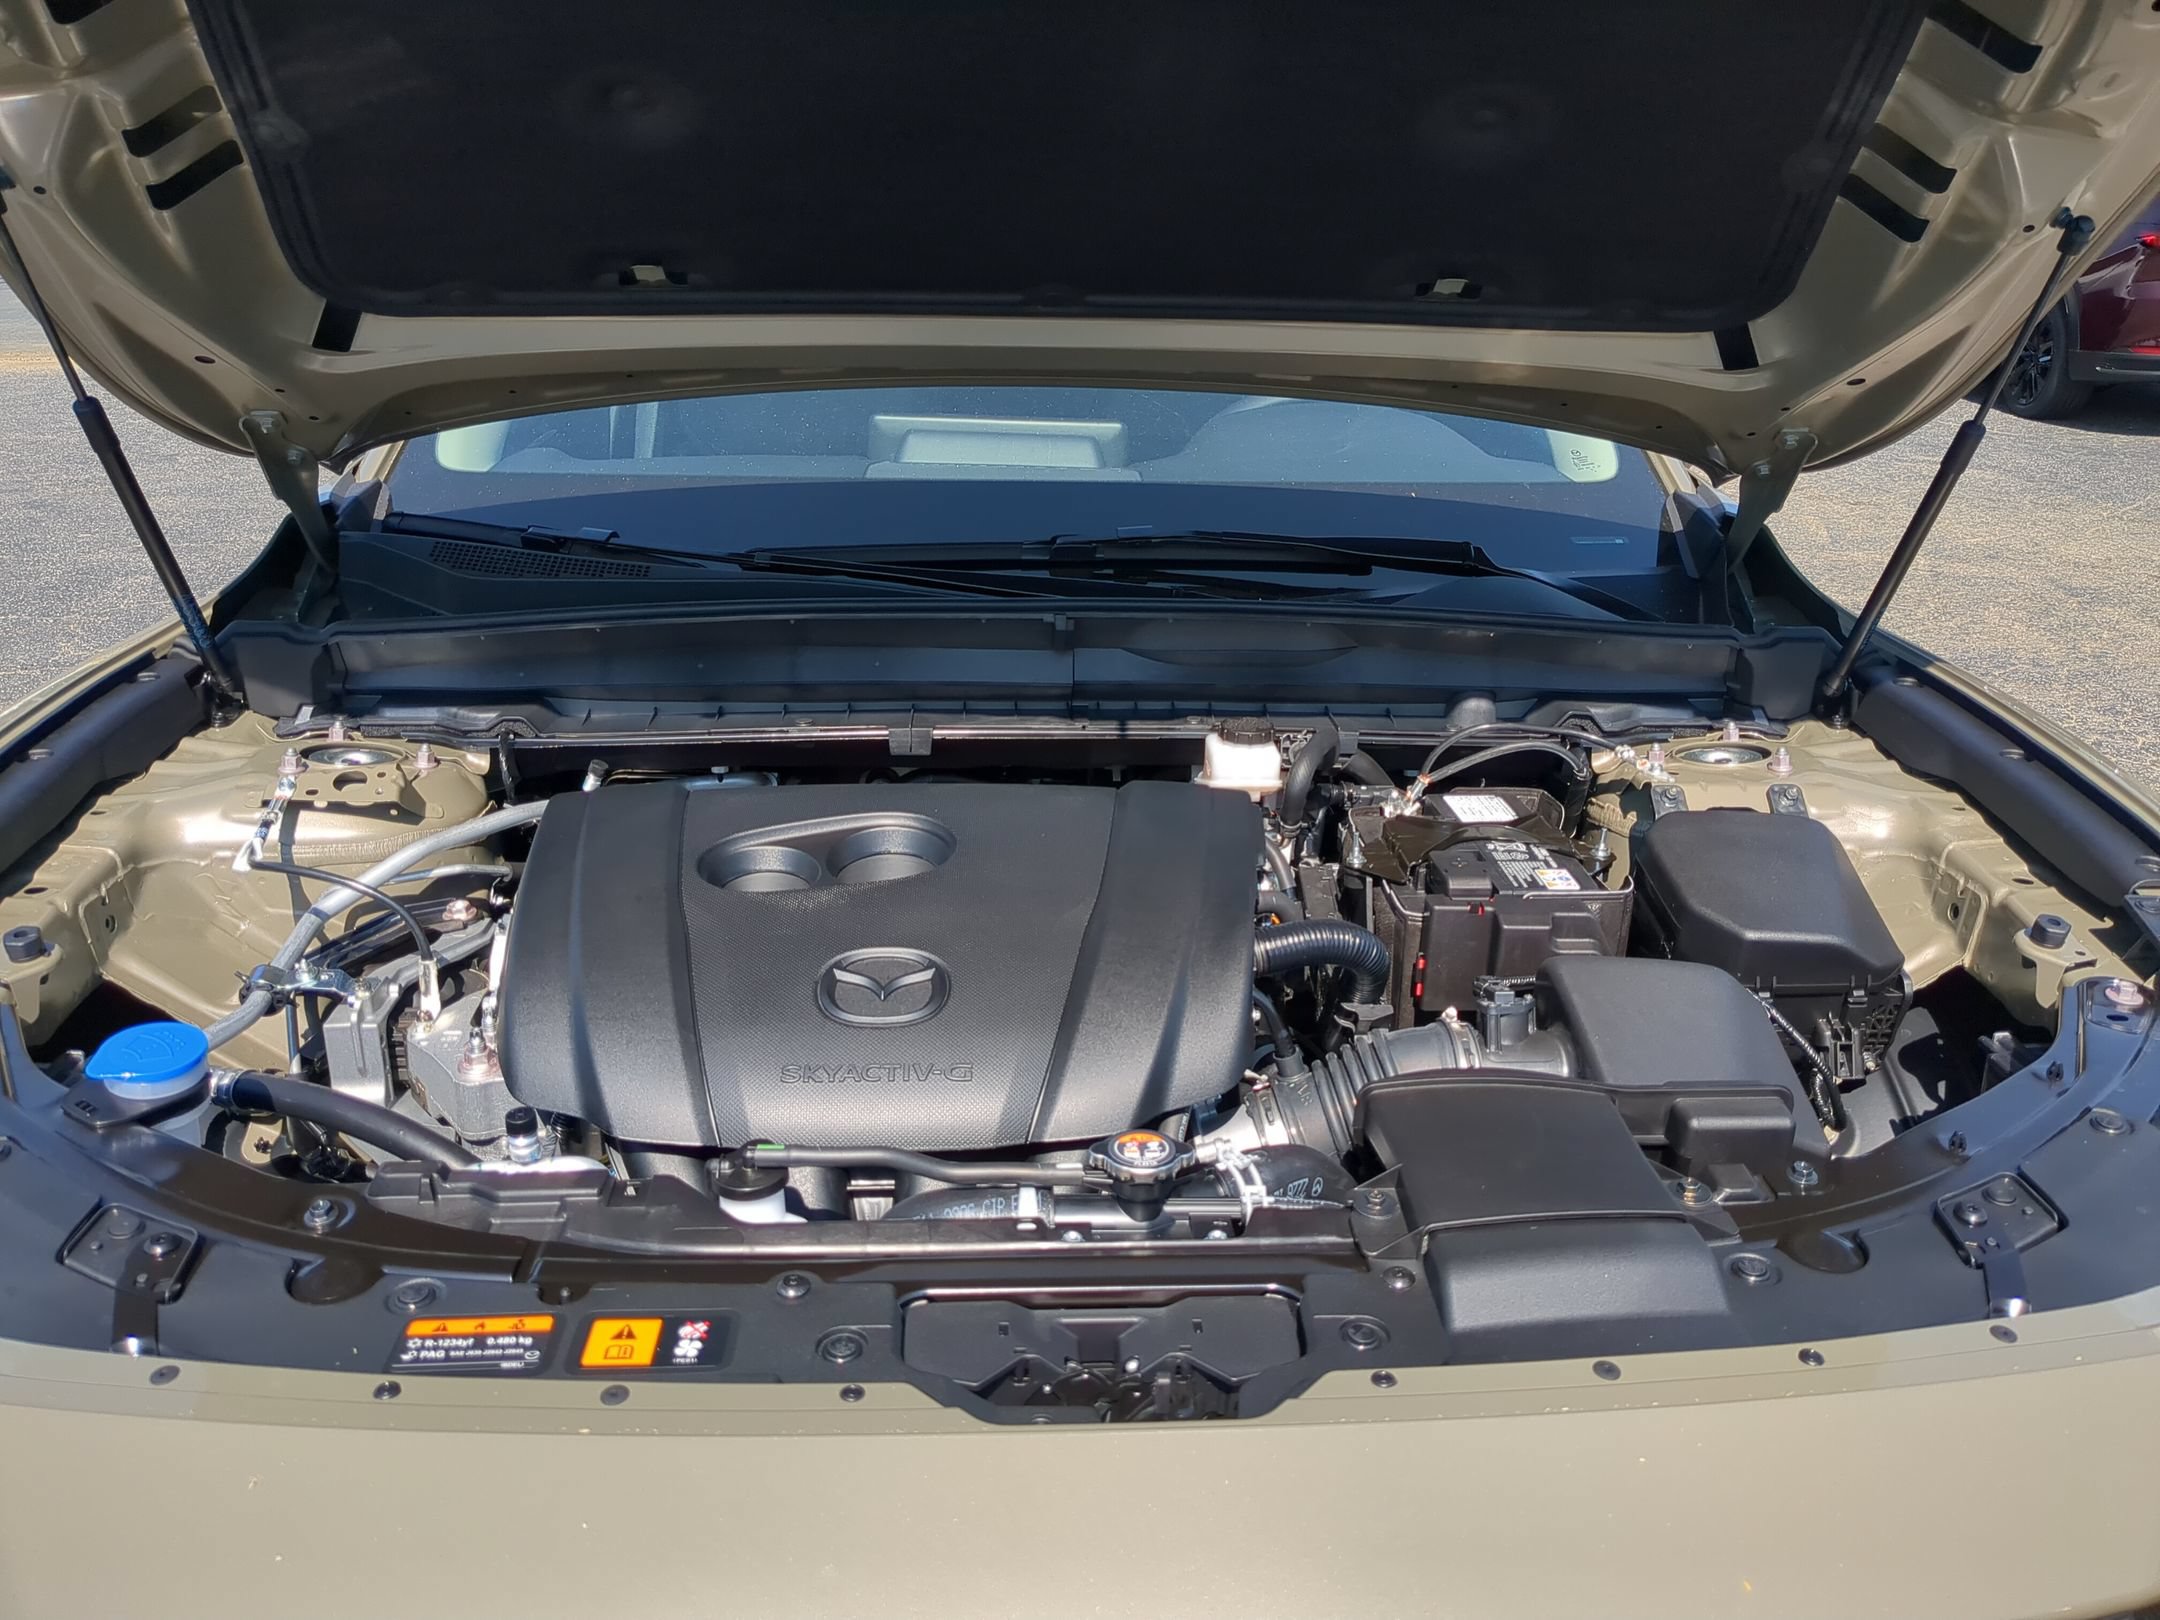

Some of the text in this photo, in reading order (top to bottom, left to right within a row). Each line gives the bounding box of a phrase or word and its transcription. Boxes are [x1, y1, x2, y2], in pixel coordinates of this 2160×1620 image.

[780, 1062, 974, 1084] SKYACTIV-G
[424, 1336, 532, 1348] R-1234yf 0.480 kg
[419, 1350, 446, 1360] PAG
